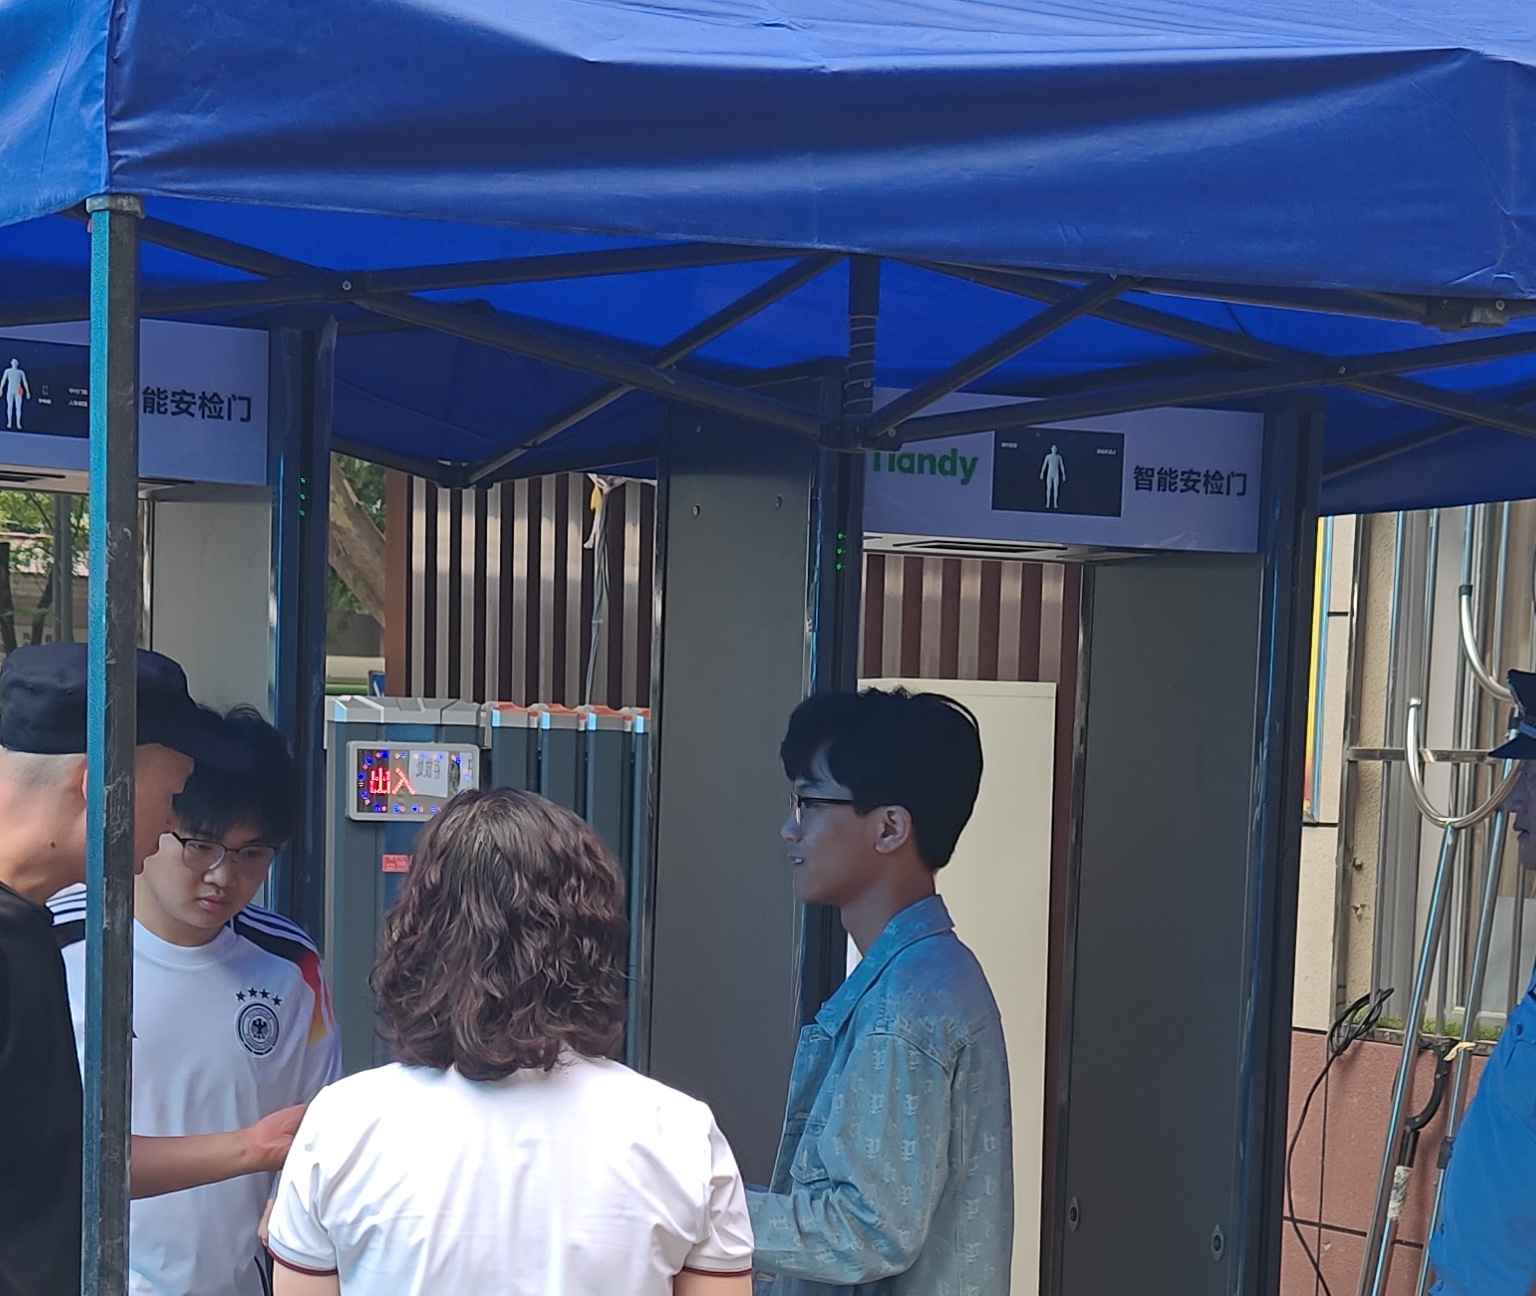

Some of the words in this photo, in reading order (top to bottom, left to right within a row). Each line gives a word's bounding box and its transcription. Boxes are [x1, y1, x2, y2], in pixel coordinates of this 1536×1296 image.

[142, 385, 252, 423] 能安检门
[1133, 464, 1248, 497] 智能安检门
[369, 767, 416, 796] 出入
